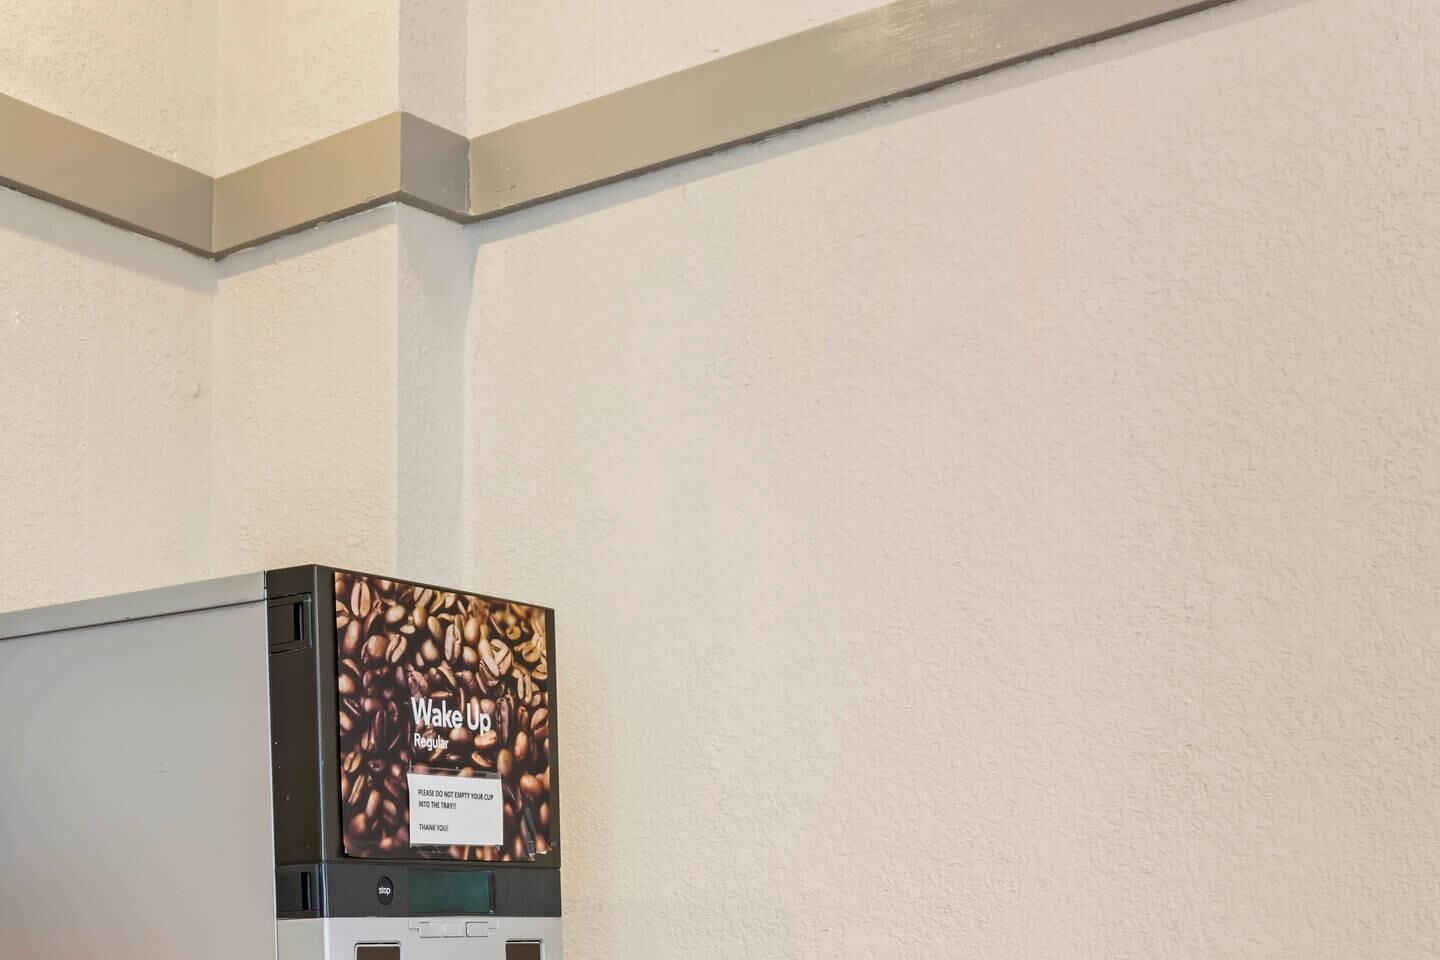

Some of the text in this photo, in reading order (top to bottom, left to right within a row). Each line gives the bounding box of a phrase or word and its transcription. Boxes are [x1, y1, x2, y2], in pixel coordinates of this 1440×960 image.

[411, 696, 491, 736] Wake Up
[413, 733, 449, 752] Regular
[418, 789, 435, 797] PLEASE
[455, 791, 471, 799] EMPTY
[471, 792, 484, 800] YOUR
[484, 793, 494, 801] CUP
[431, 801, 440, 809] THE
[419, 823, 449, 832] THANK YOU!
[378, 885, 391, 896] stop
